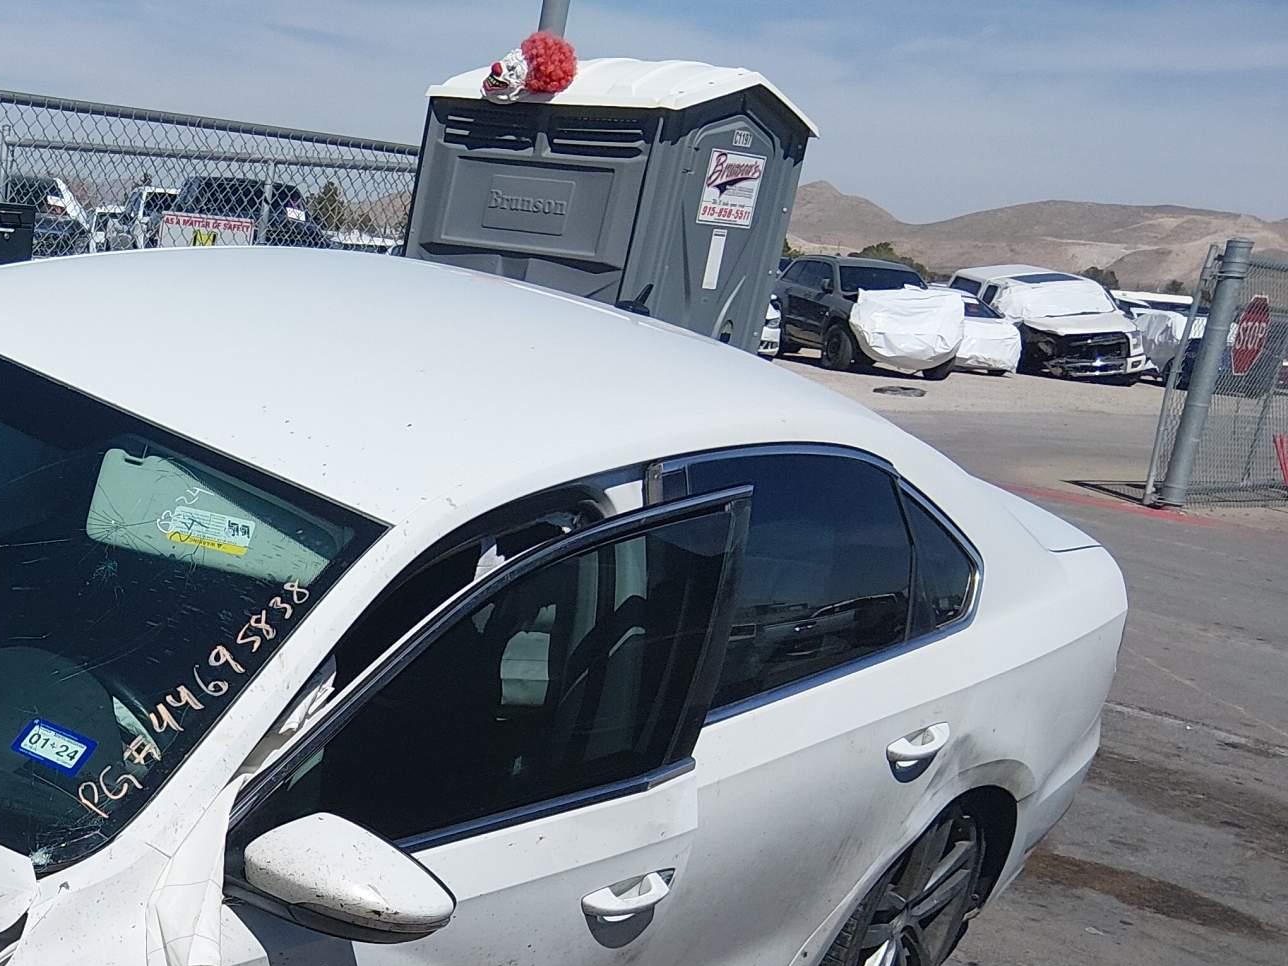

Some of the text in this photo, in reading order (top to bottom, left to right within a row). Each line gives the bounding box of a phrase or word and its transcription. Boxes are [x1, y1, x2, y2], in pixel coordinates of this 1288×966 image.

[488, 189, 567, 215] Brunson
[223, 222, 250, 232] SAFETY
[1236, 321, 1267, 349] STOP
[55, 744, 79, 762] 24
